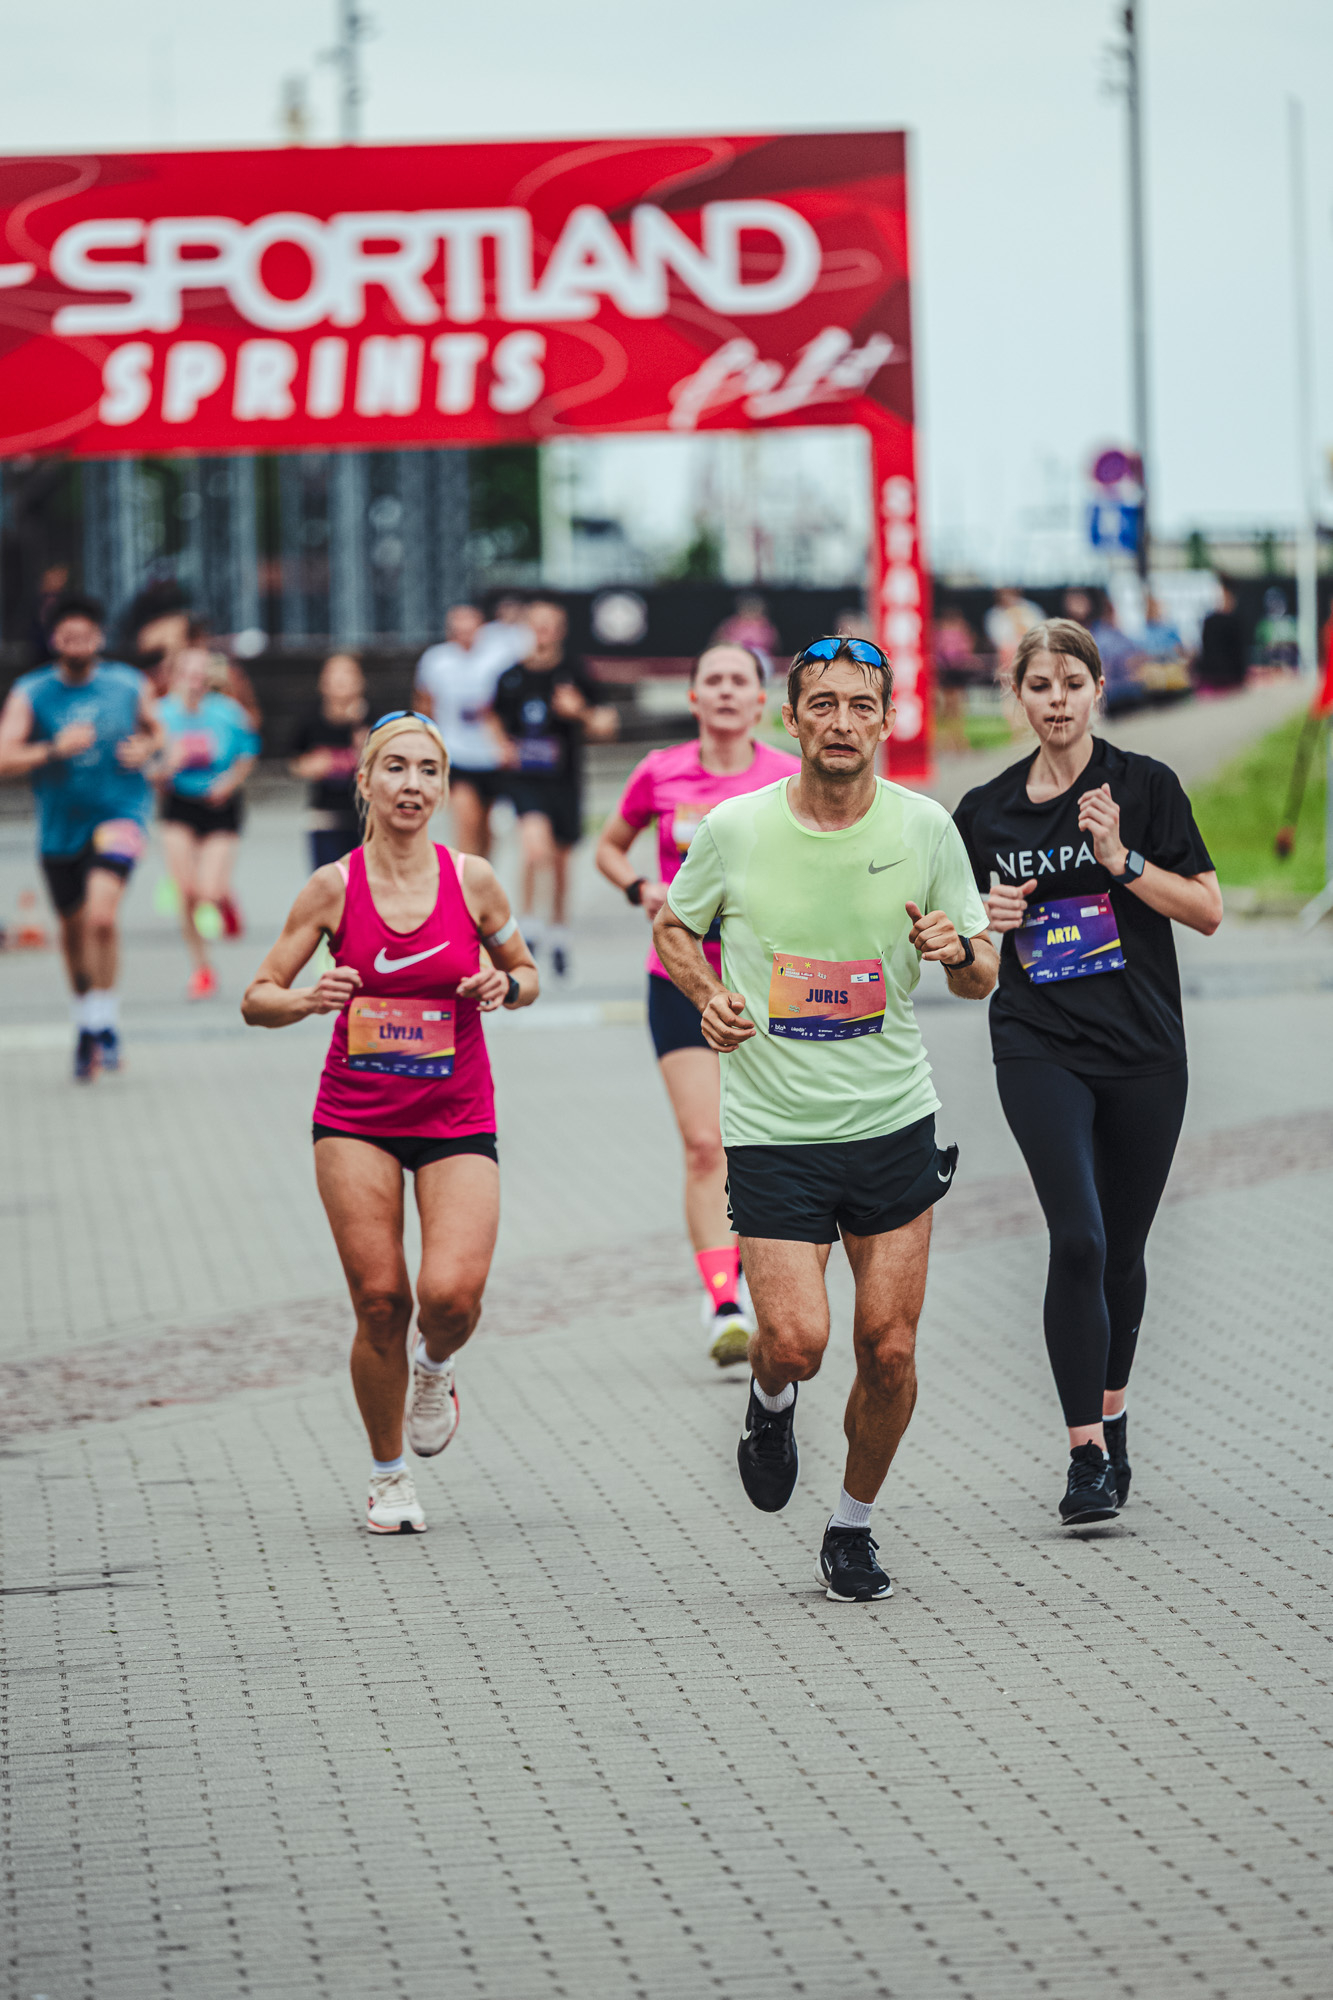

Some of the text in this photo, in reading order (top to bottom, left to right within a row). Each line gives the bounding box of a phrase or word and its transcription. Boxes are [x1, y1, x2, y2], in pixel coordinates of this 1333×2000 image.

[52, 201, 820, 336] SPORTLAND
[100, 331, 549, 425] SPRINTS
[1047, 926, 1081, 945] ARTA
[806, 989, 849, 1004] JURIS
